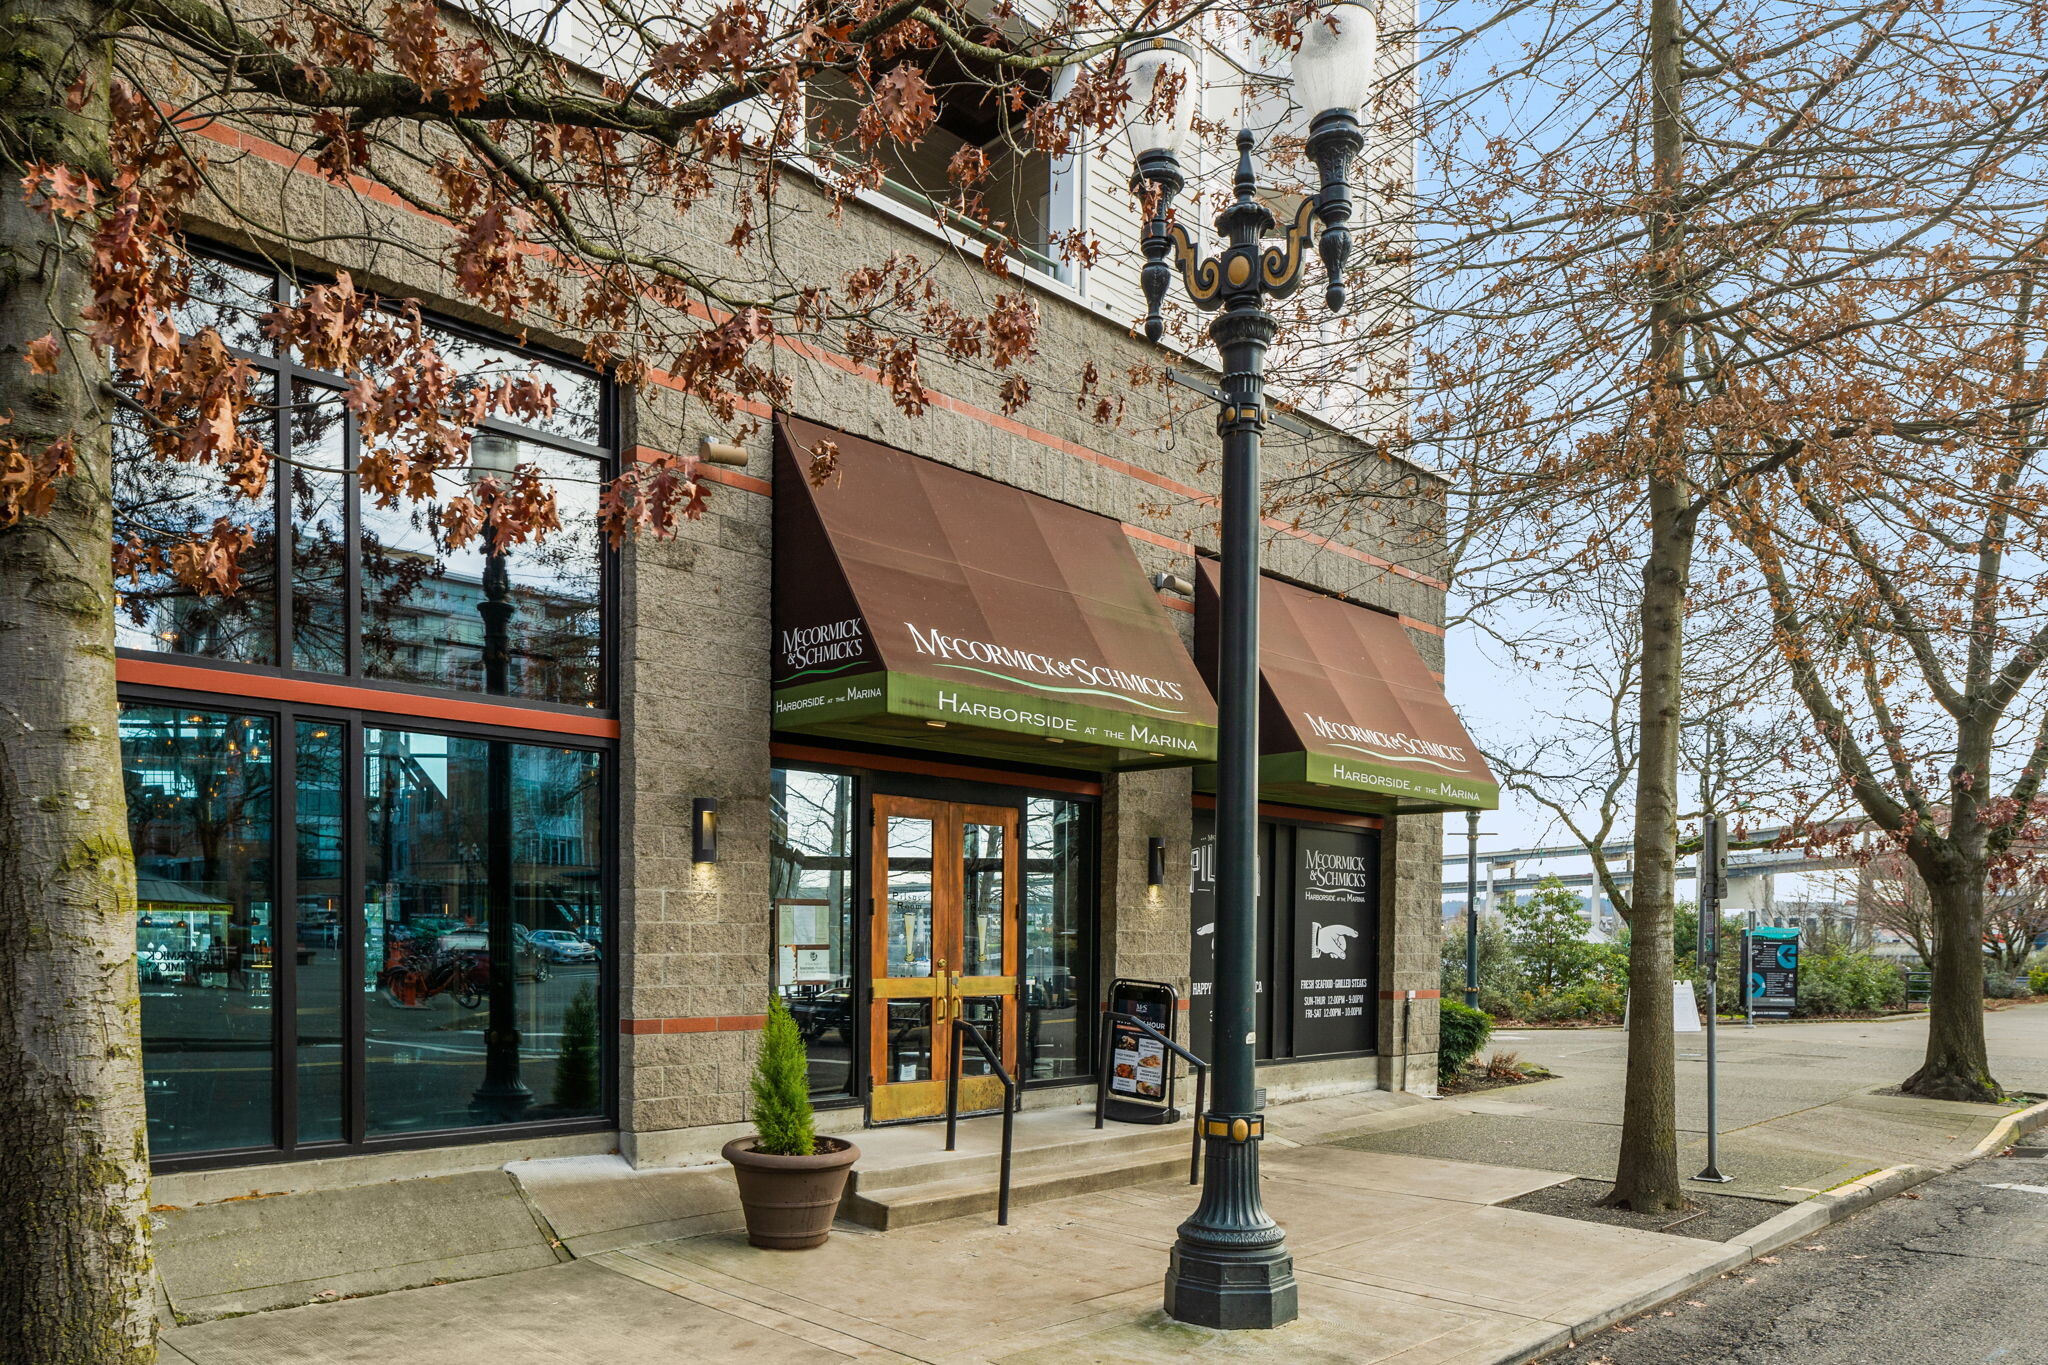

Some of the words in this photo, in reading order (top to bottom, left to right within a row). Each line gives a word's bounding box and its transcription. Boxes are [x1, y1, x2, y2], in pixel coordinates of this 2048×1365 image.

[776, 696, 825, 713] HARBORSIDE
[848, 687, 882, 701] MARINA
[938, 690, 1077, 731] HARBORSIDE
[1084, 727, 1097, 736] AT
[1104, 730, 1125, 741] THE
[1131, 724, 1198, 752] MARINA
[1333, 763, 1411, 790] HARBORSIDE
[1440, 782, 1481, 801] MARINA
[1192, 982, 1213, 995] HAPPY
[1301, 979, 1314, 989] FRESH
[1352, 978, 1367, 988] STEAKS
[1304, 996, 1326, 1006] SUN-THUR
[1305, 1008, 1322, 1018] FRI-SAT
